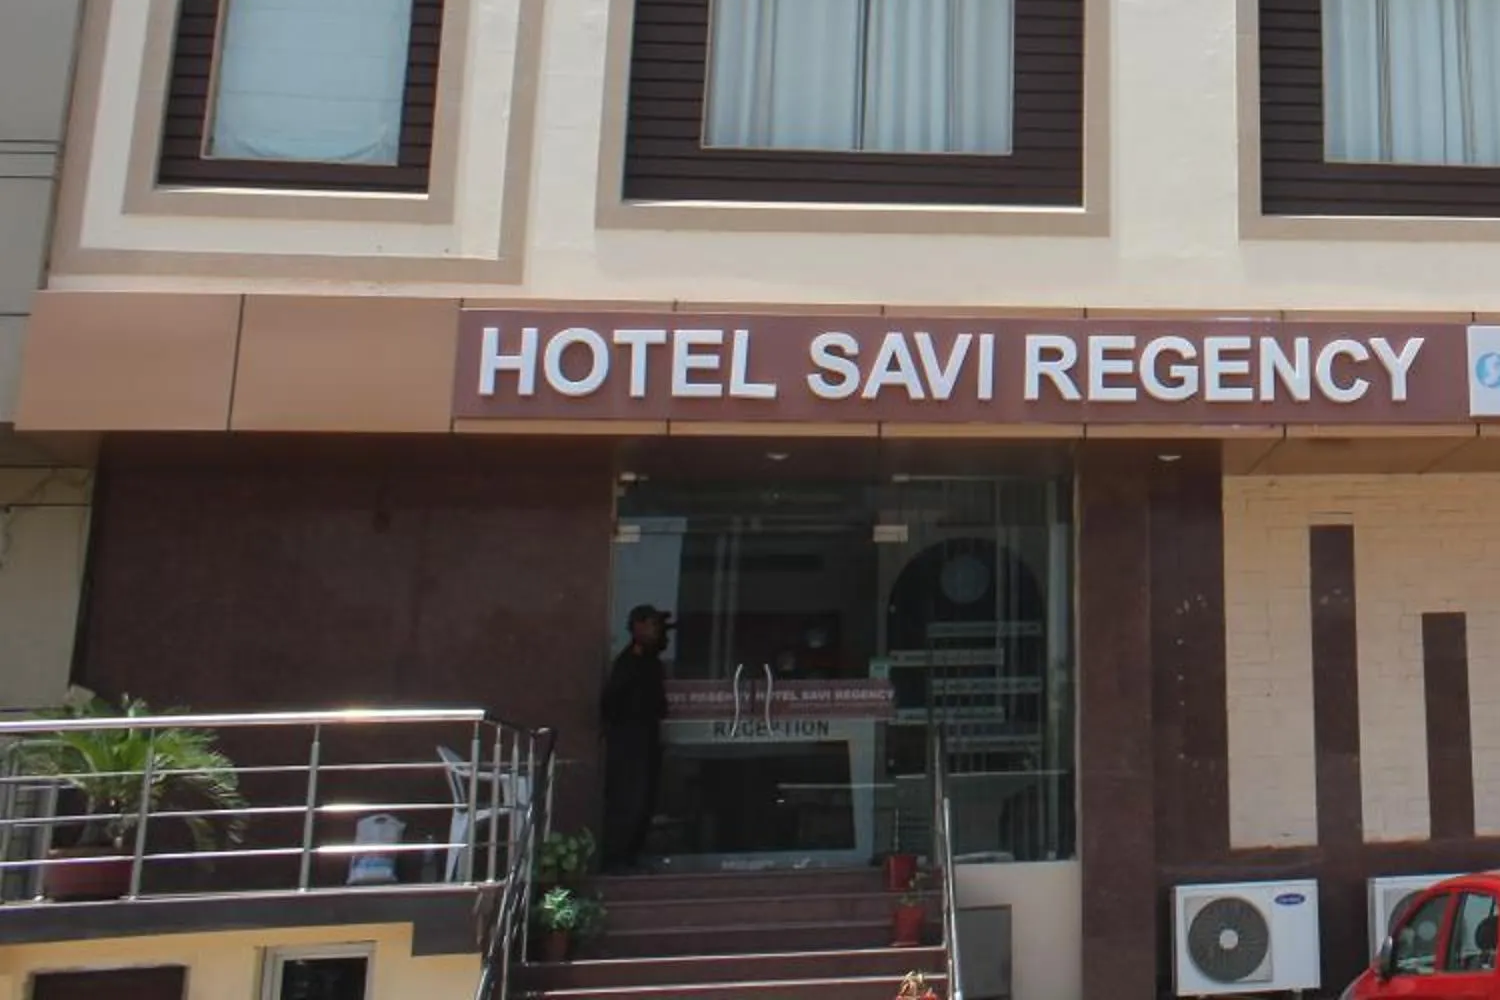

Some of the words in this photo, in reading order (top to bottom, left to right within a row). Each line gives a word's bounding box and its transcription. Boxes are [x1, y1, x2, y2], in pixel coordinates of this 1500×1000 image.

[477, 326, 777, 401] HOTEL
[807, 330, 996, 402] SAVI
[1023, 333, 1425, 404] REGENCY
[834, 689, 895, 699] REGENCY
